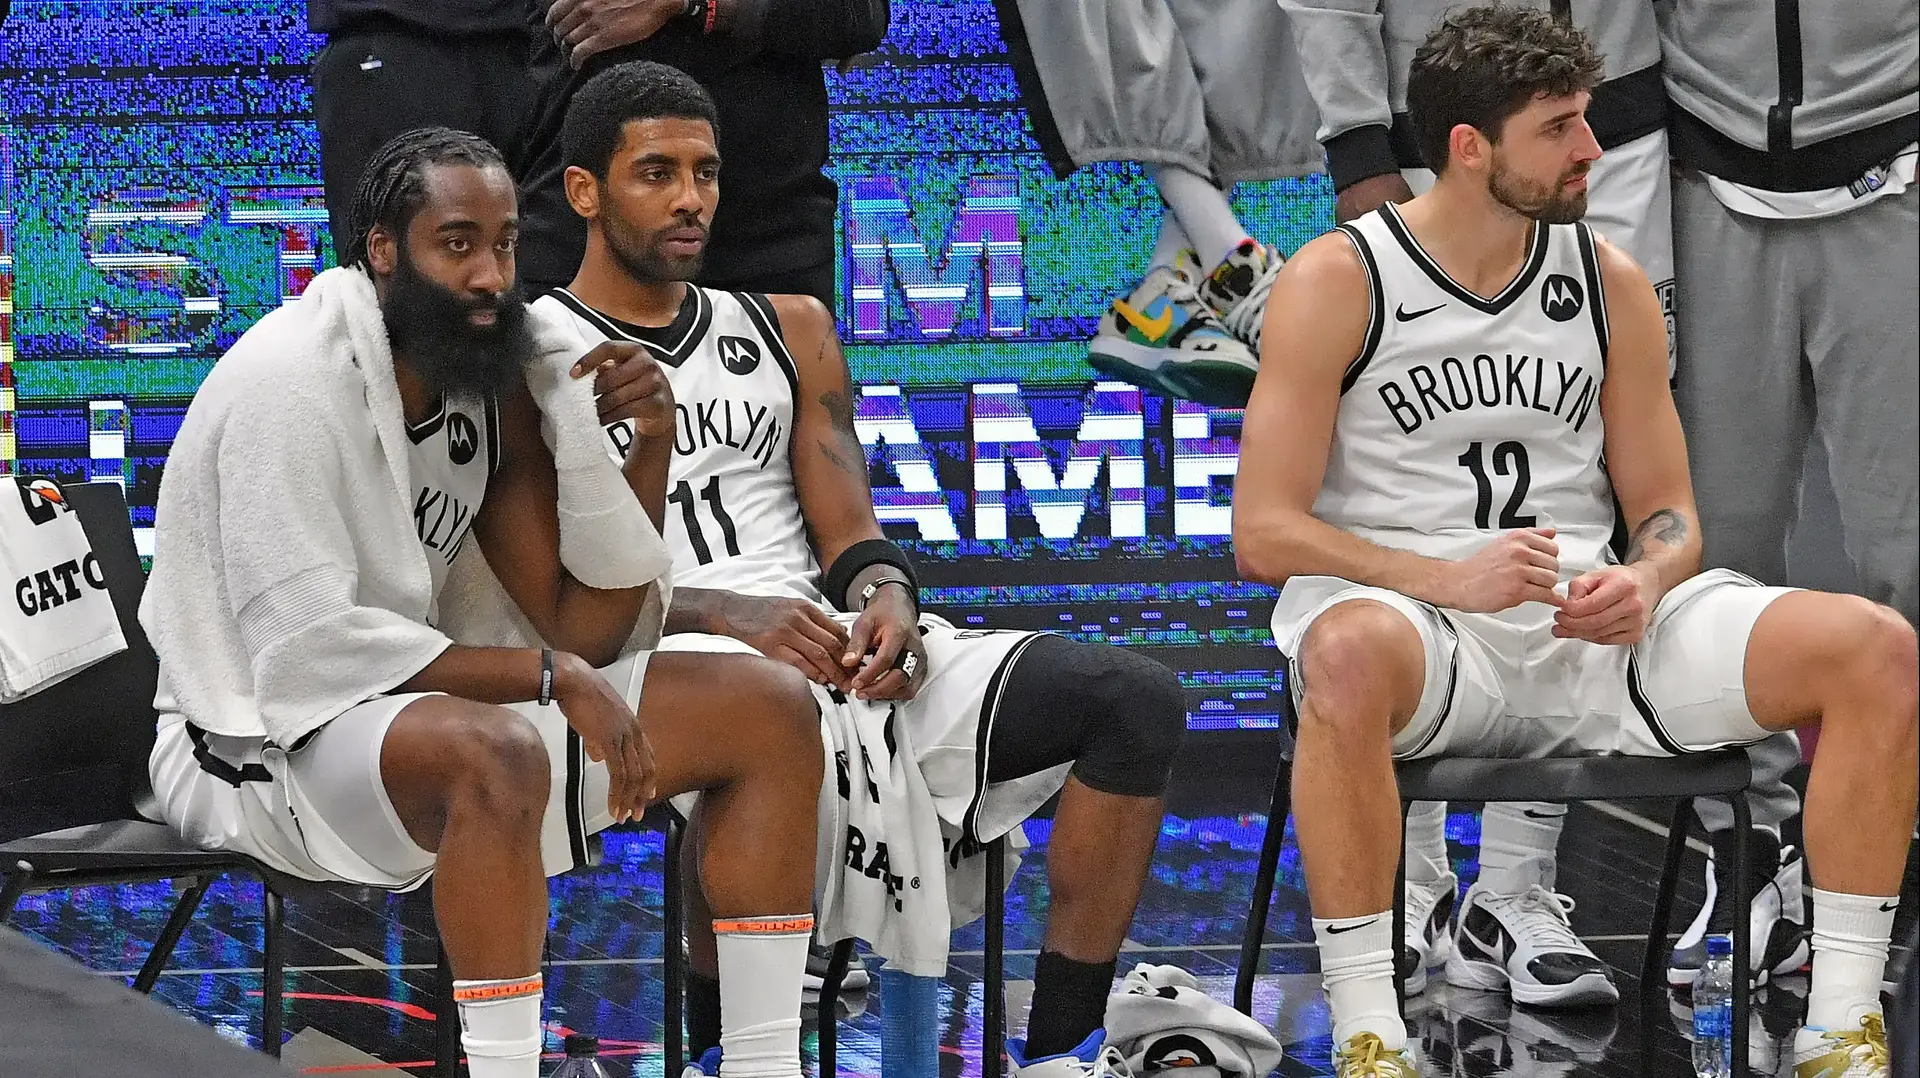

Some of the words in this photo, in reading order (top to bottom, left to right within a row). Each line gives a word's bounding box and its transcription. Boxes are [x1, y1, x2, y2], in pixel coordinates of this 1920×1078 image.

[1378, 354, 1597, 434] BROOKLYN
[667, 476, 741, 565] 11
[1458, 441, 1537, 529] 12
